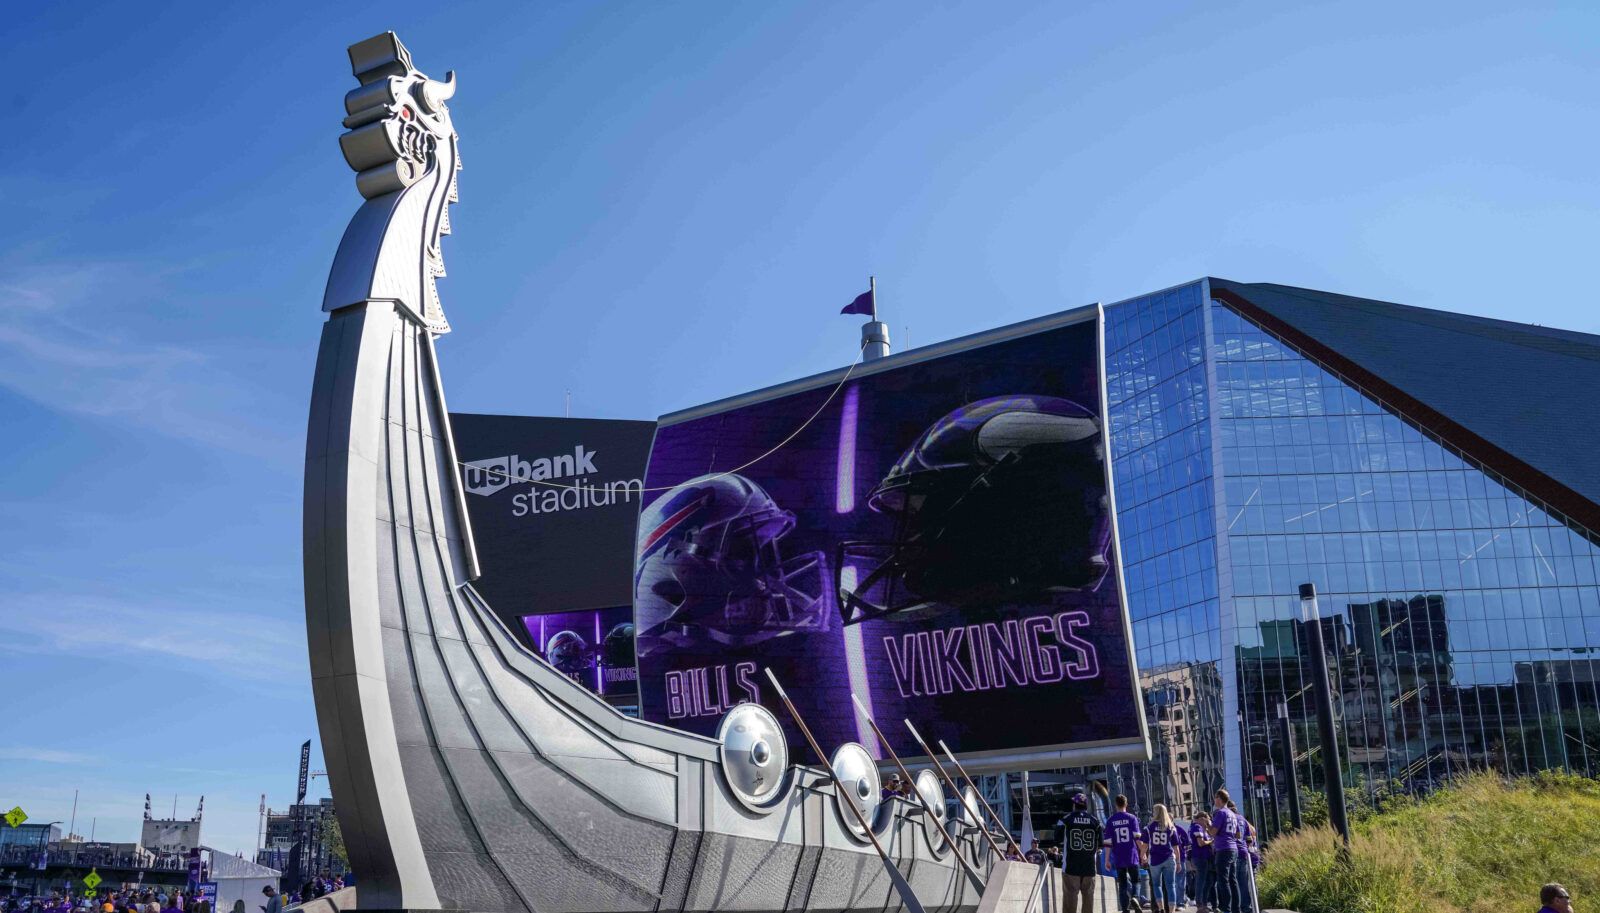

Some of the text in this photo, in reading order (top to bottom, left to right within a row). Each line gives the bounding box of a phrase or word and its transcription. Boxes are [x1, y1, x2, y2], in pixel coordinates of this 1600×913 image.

[512, 478, 643, 517] stadium
[883, 611, 1099, 698] VIKINGS
[665, 662, 761, 719] BILLS
[1073, 817, 1091, 825] ALLEN
[1070, 829, 1095, 851] 69
[1114, 827, 1130, 843] 19
[1152, 832, 1168, 845] 69
